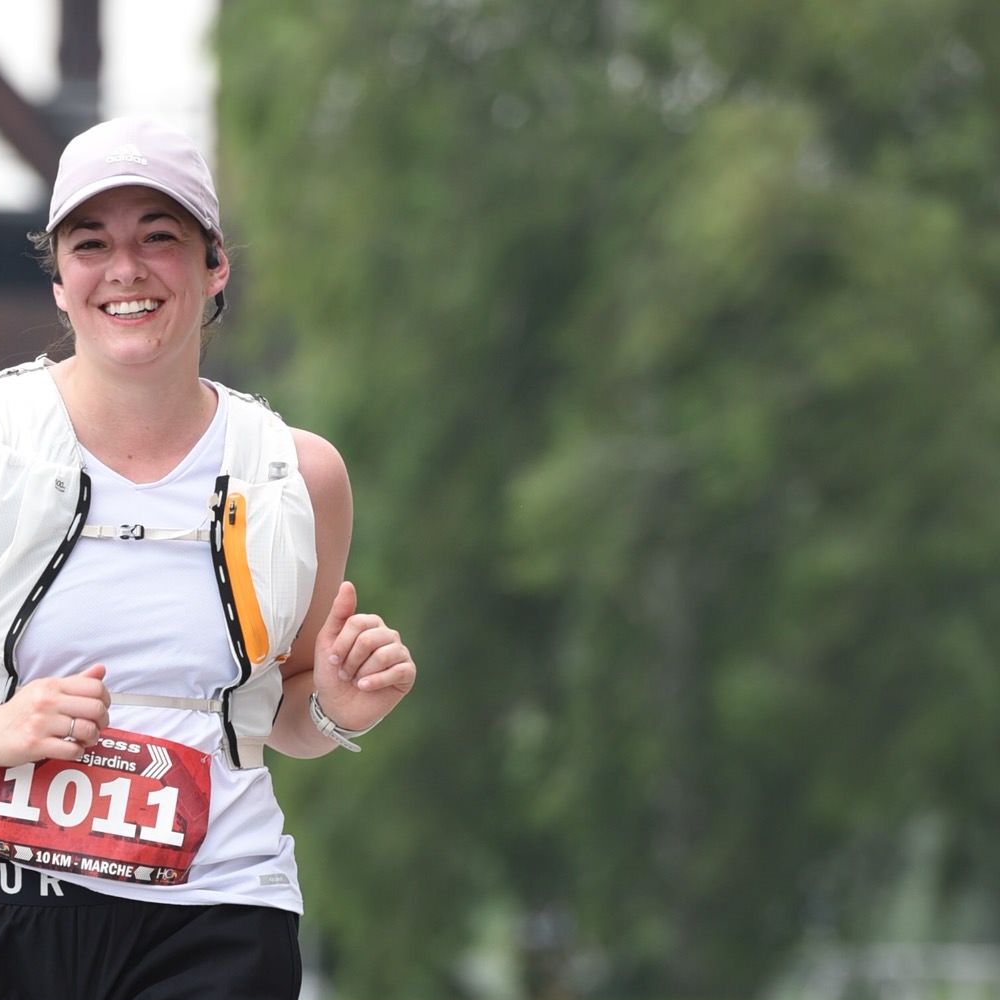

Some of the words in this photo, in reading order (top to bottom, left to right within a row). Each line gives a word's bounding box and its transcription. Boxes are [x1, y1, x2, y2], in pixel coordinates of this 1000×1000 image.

[105, 154, 148, 166] adidas
[35, 850, 51, 864] 10
[51, 853, 72, 868] KM
[80, 857, 134, 878] MARCHE
